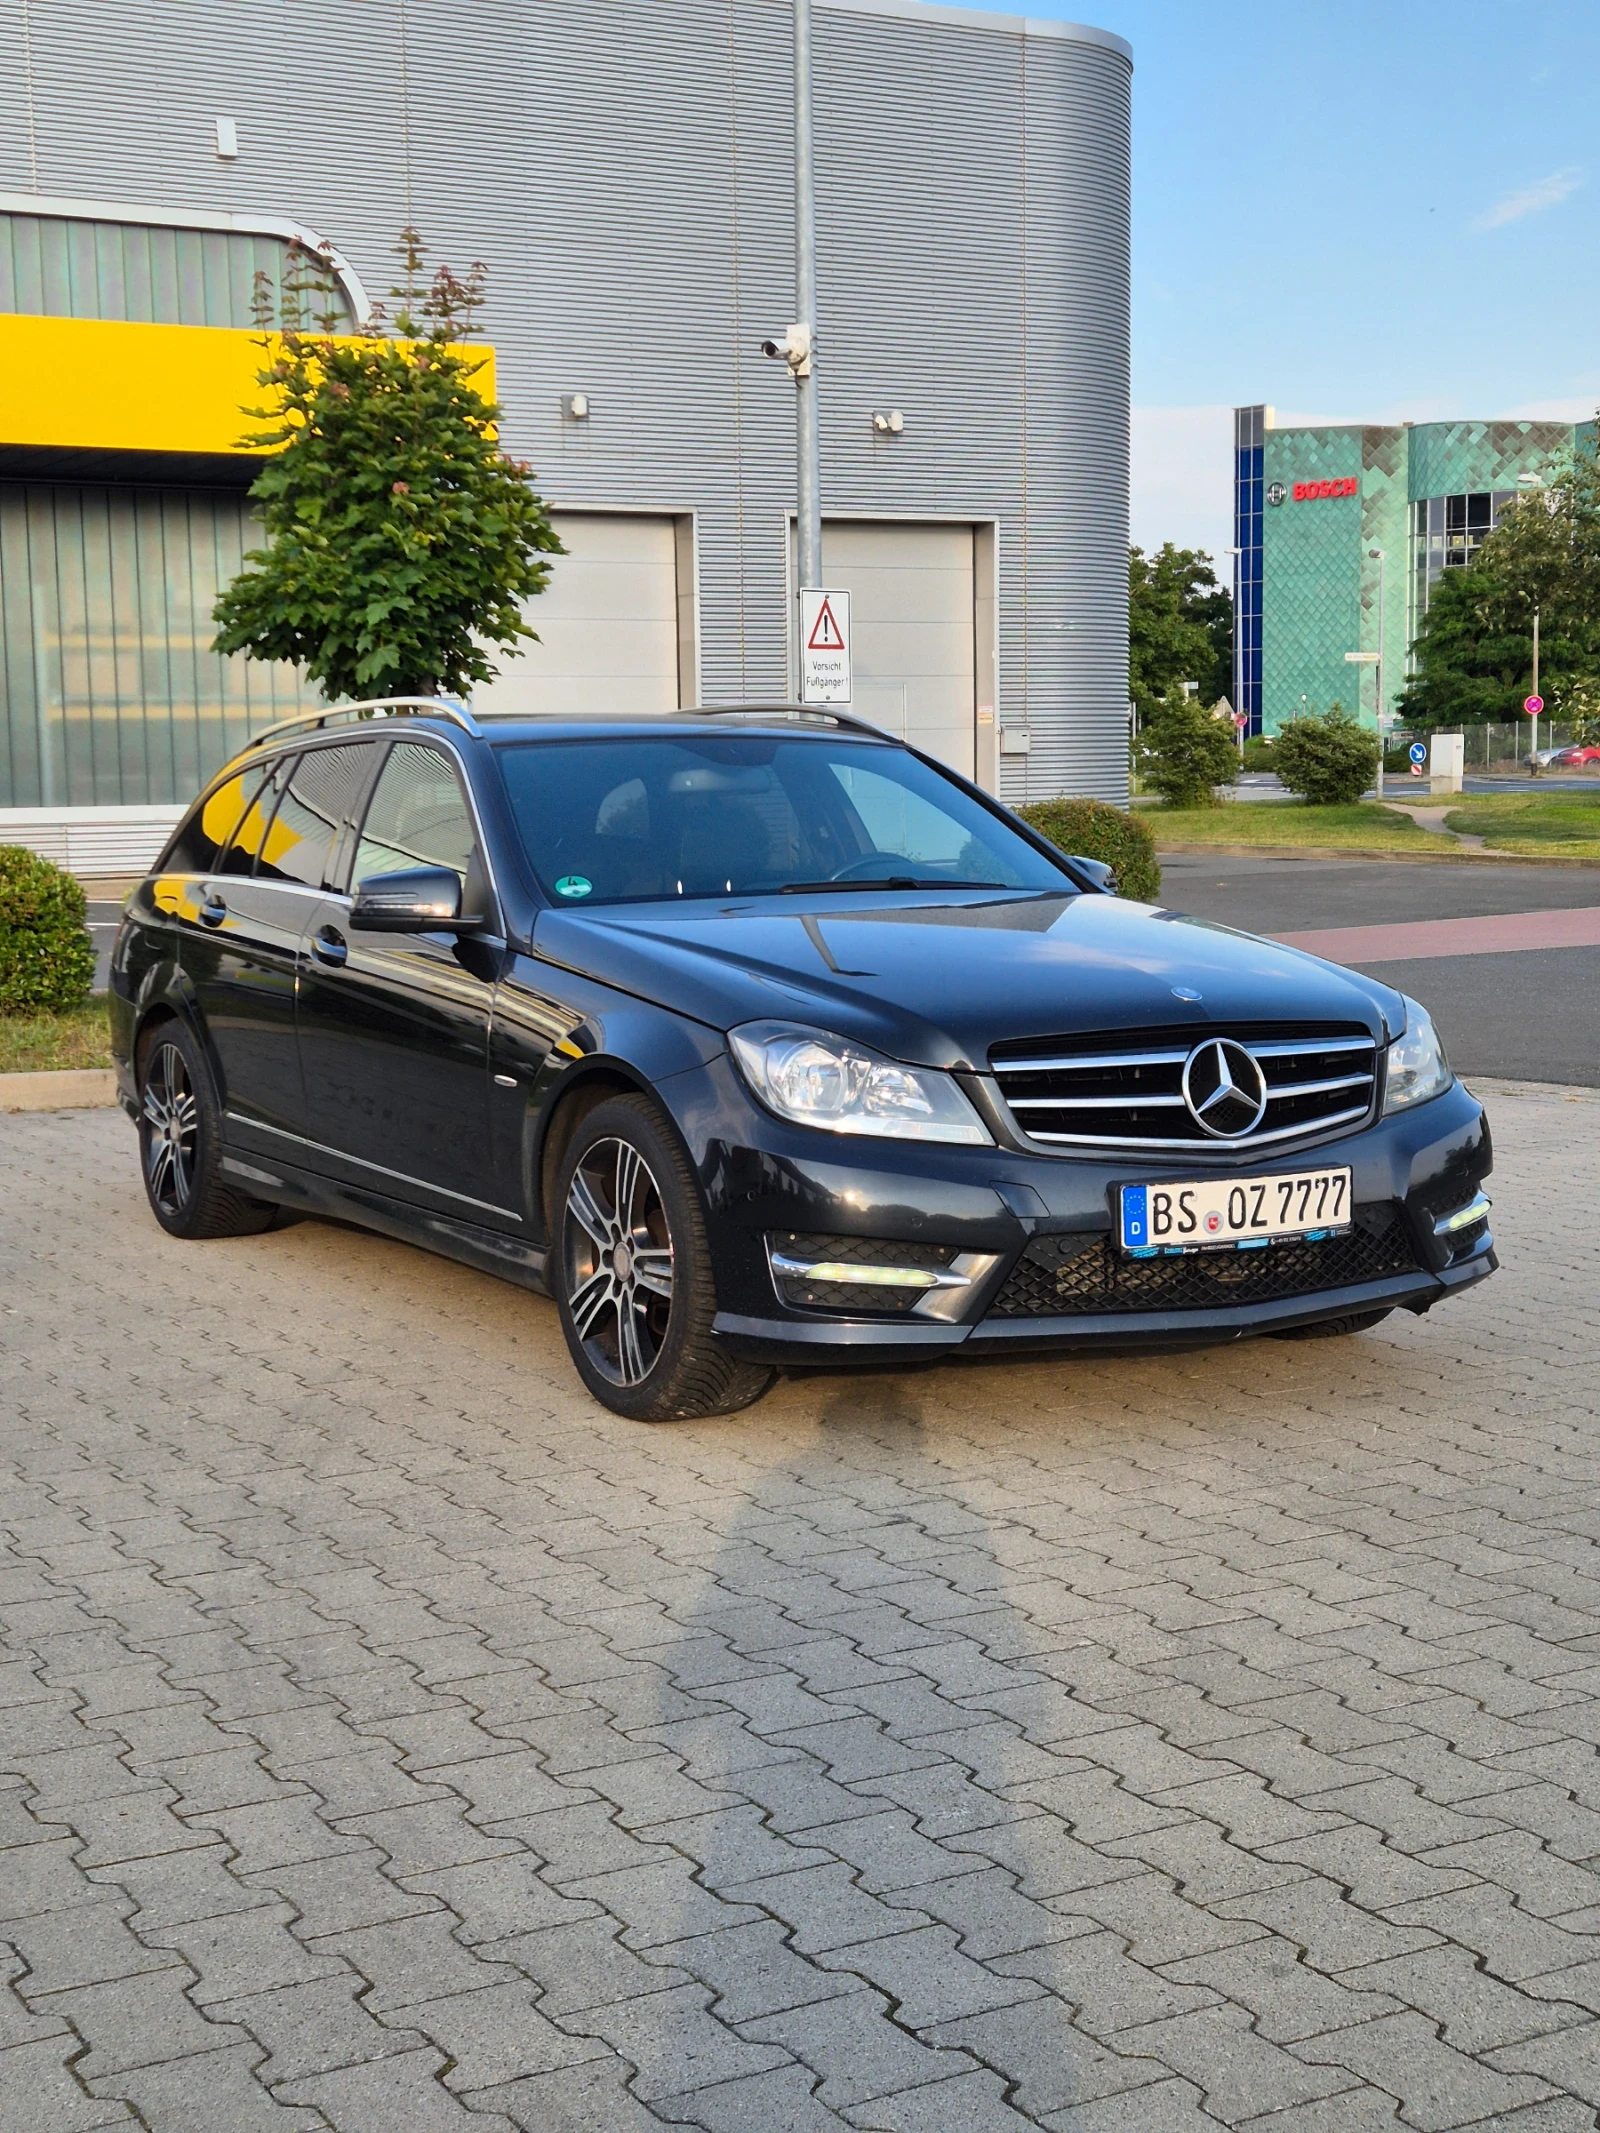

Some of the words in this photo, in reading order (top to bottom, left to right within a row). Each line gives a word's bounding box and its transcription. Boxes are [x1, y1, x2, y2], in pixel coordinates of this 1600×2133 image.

[1293, 477, 1357, 501] BOSCH
[812, 661, 841, 671] Vorsicht
[1153, 1190, 1197, 1235] BS
[1228, 1184, 1268, 1229] OZ
[1278, 1174, 1347, 1224] 7777
[1131, 1221, 1141, 1235] D
